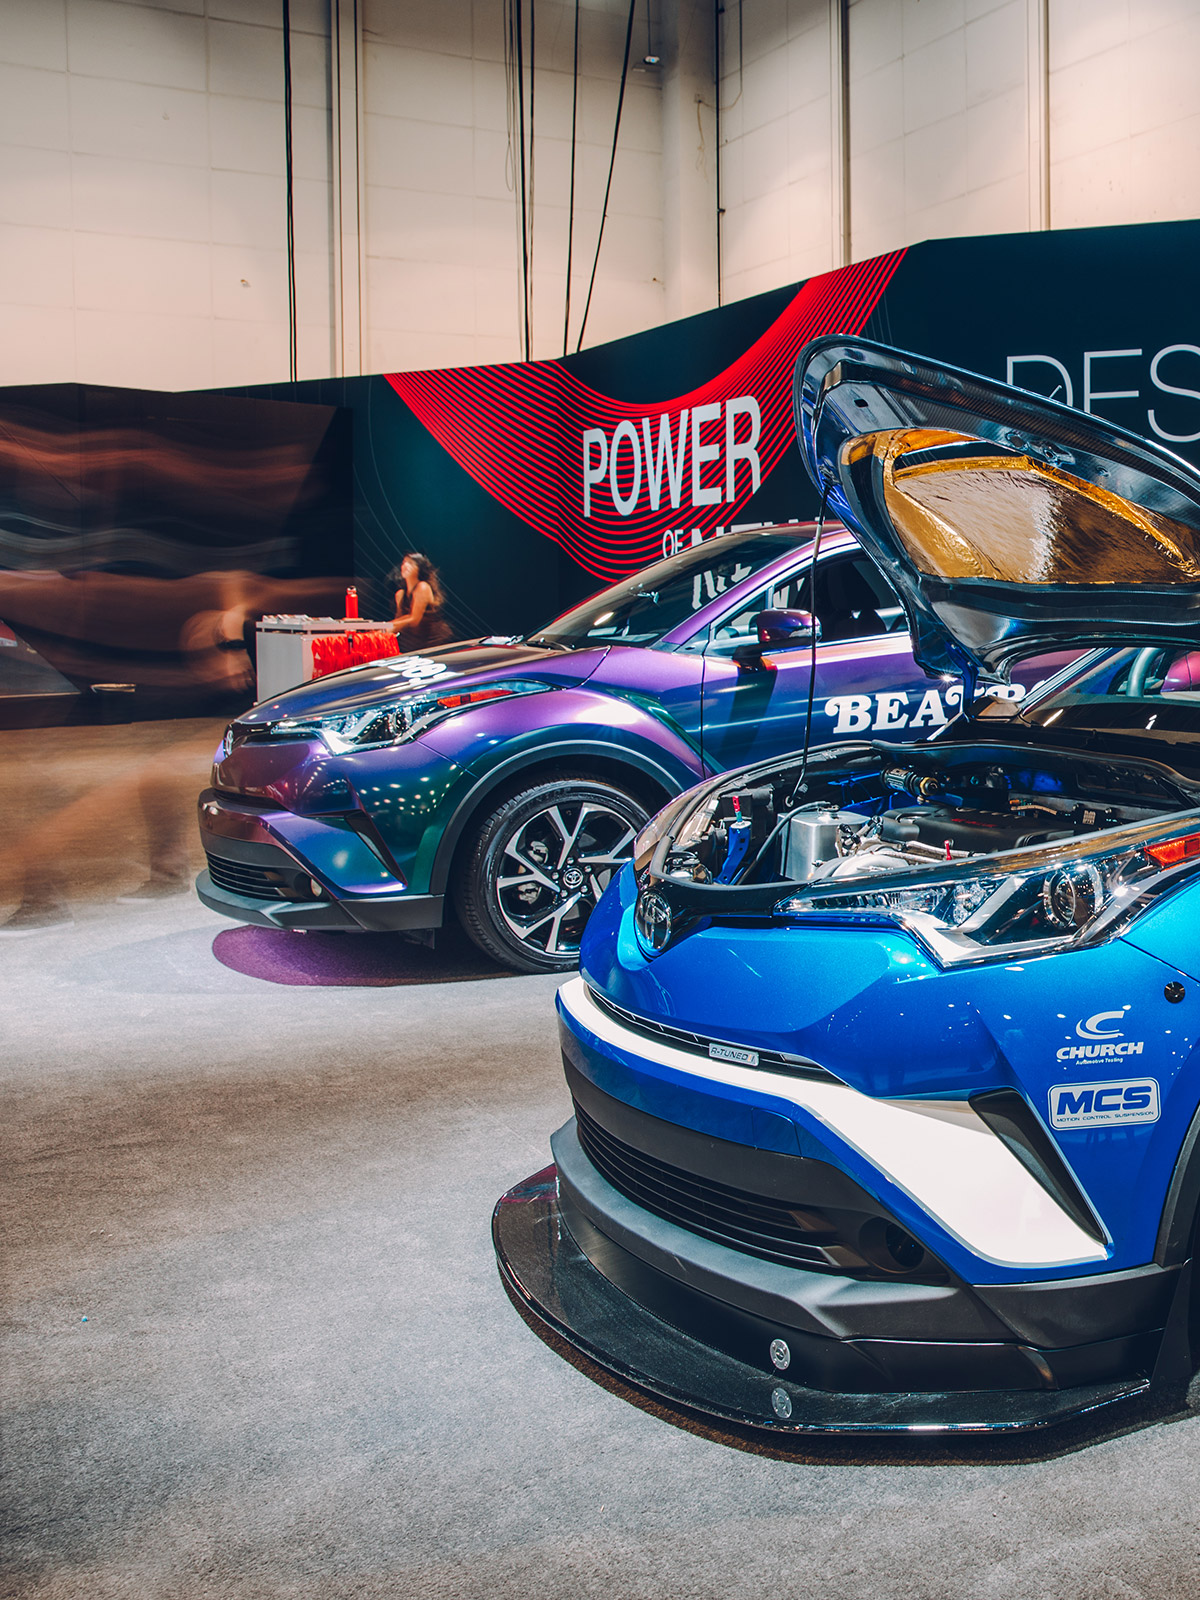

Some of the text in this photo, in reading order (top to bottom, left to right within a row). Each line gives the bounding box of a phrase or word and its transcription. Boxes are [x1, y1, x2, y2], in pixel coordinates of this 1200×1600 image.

[583, 396, 761, 517] POWER
[662, 529, 684, 558] OF
[1056, 1041, 1144, 1060] CHURCH
[1076, 1058, 1104, 1066] Automotive
[1056, 1085, 1152, 1116] MCS
[1114, 1111, 1154, 1119] SUSPENSION
